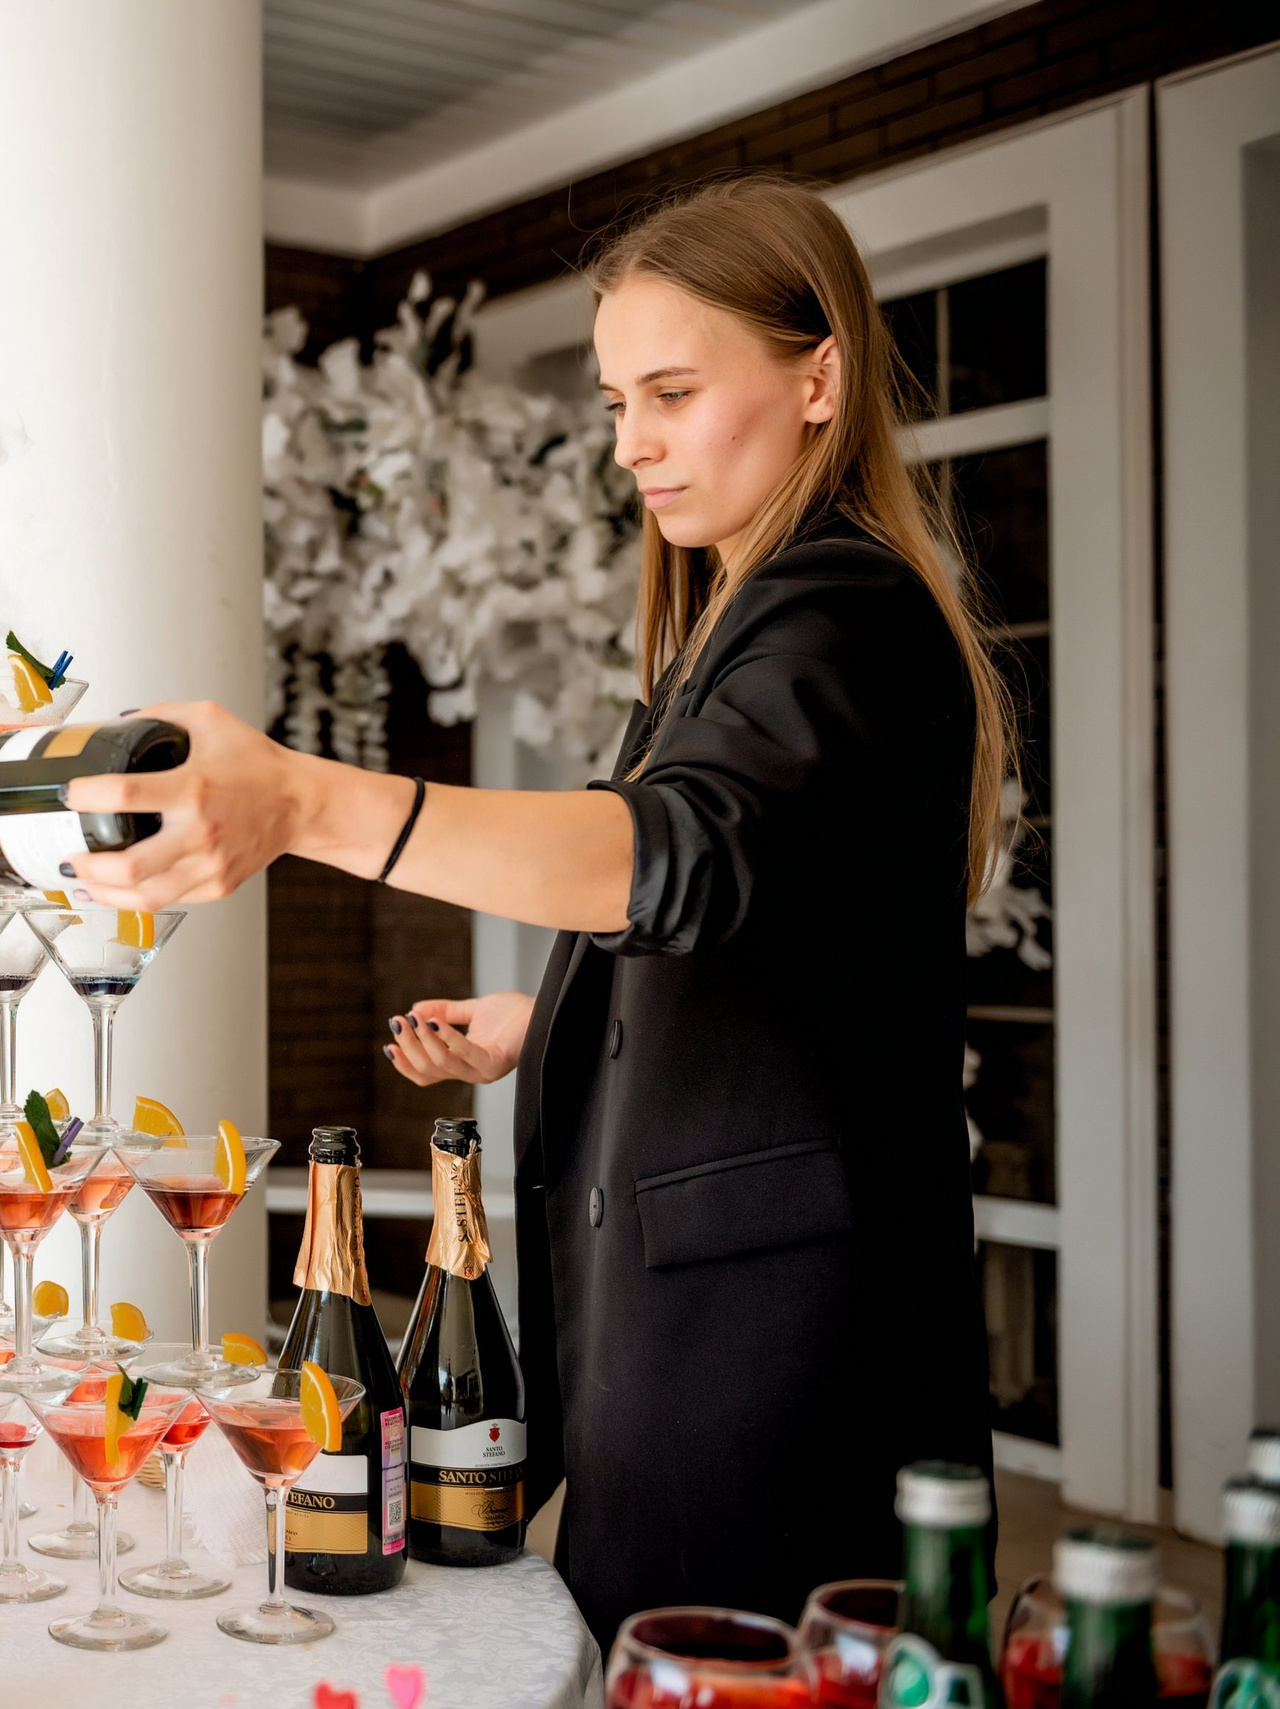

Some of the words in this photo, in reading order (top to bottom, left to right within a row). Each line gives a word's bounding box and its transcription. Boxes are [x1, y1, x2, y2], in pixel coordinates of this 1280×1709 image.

[482, 1450, 506, 1458] STEFANO
[438, 1470, 487, 1484] SANTO
[288, 1491, 336, 1509] EFANO
